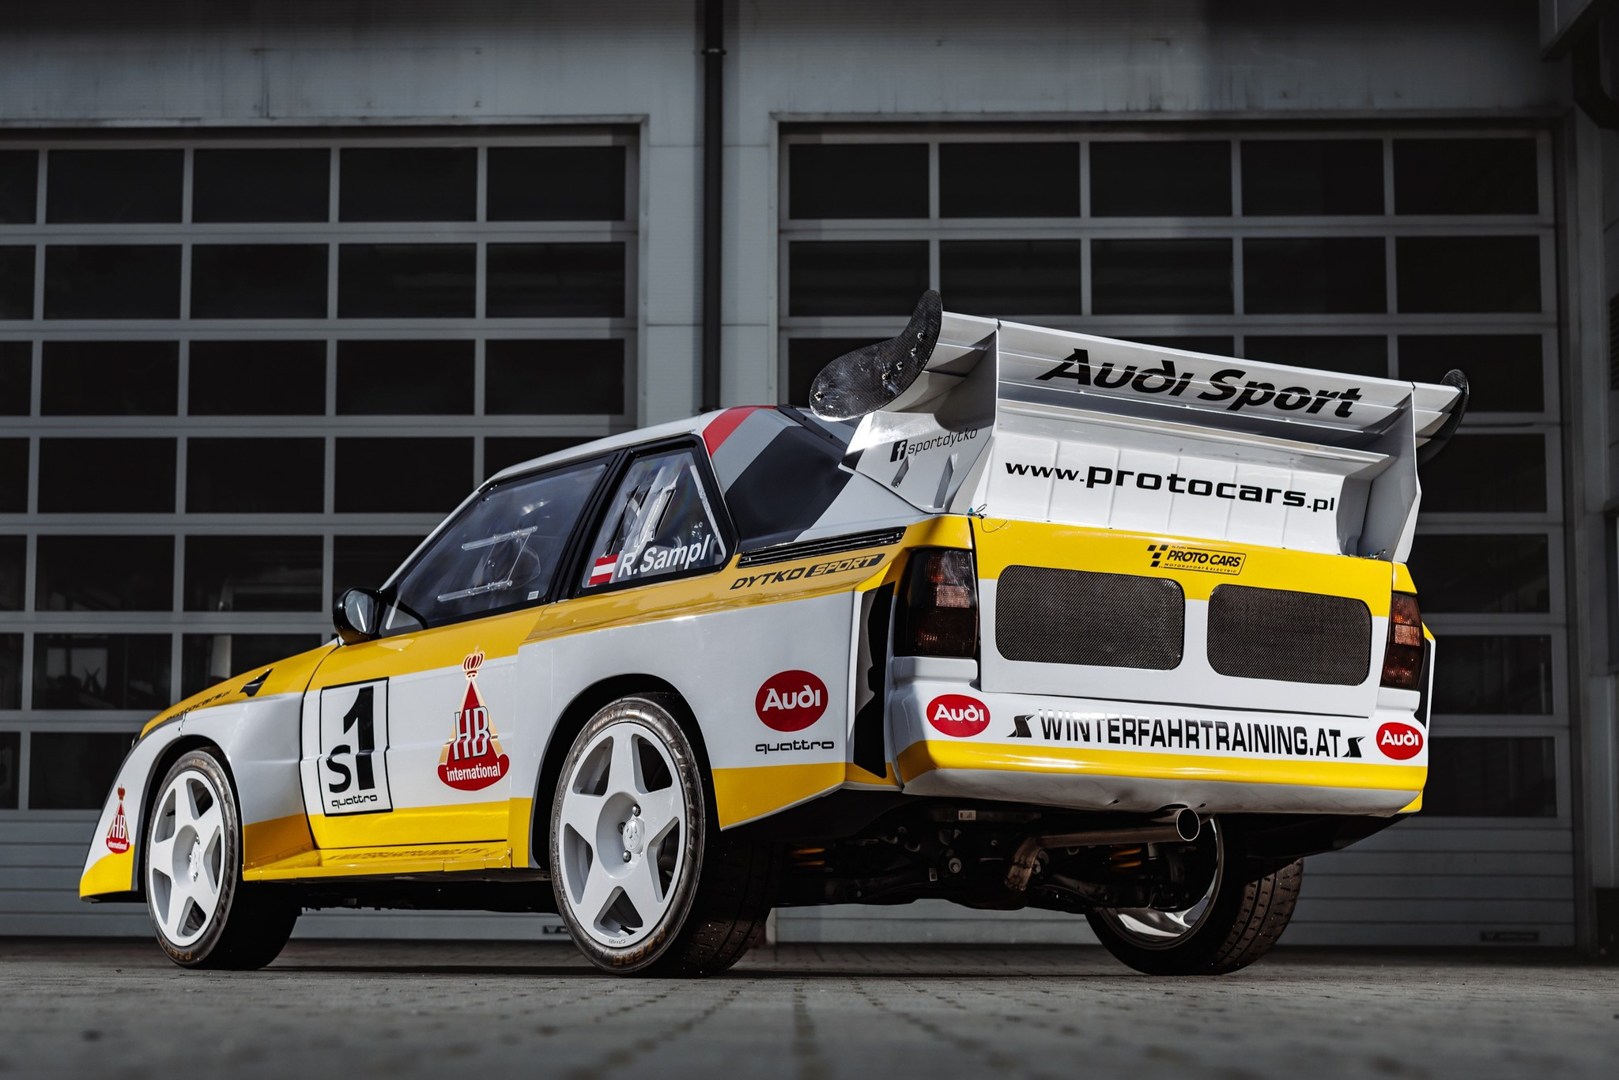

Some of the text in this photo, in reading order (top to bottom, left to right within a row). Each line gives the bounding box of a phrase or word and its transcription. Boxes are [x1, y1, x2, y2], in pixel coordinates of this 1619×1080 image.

[1036, 347, 1362, 419] Audi Sport
[908, 427, 978, 456] sportdytko
[1005, 461, 1335, 514] www.protocars.pl
[1167, 550, 1241, 567] PROTO CARS
[729, 554, 880, 590] DYTKO SPORT
[762, 684, 820, 712] Audi
[933, 703, 986, 722] Audi
[453, 705, 491, 761] HB
[1039, 708, 1341, 758] WINTERFAHRTRAINING.AT
[1381, 728, 1420, 747] Audi
[755, 740, 834, 754] quattro
[446, 761, 501, 782] international
[331, 794, 378, 808] quattro
[112, 814, 126, 839] HB
